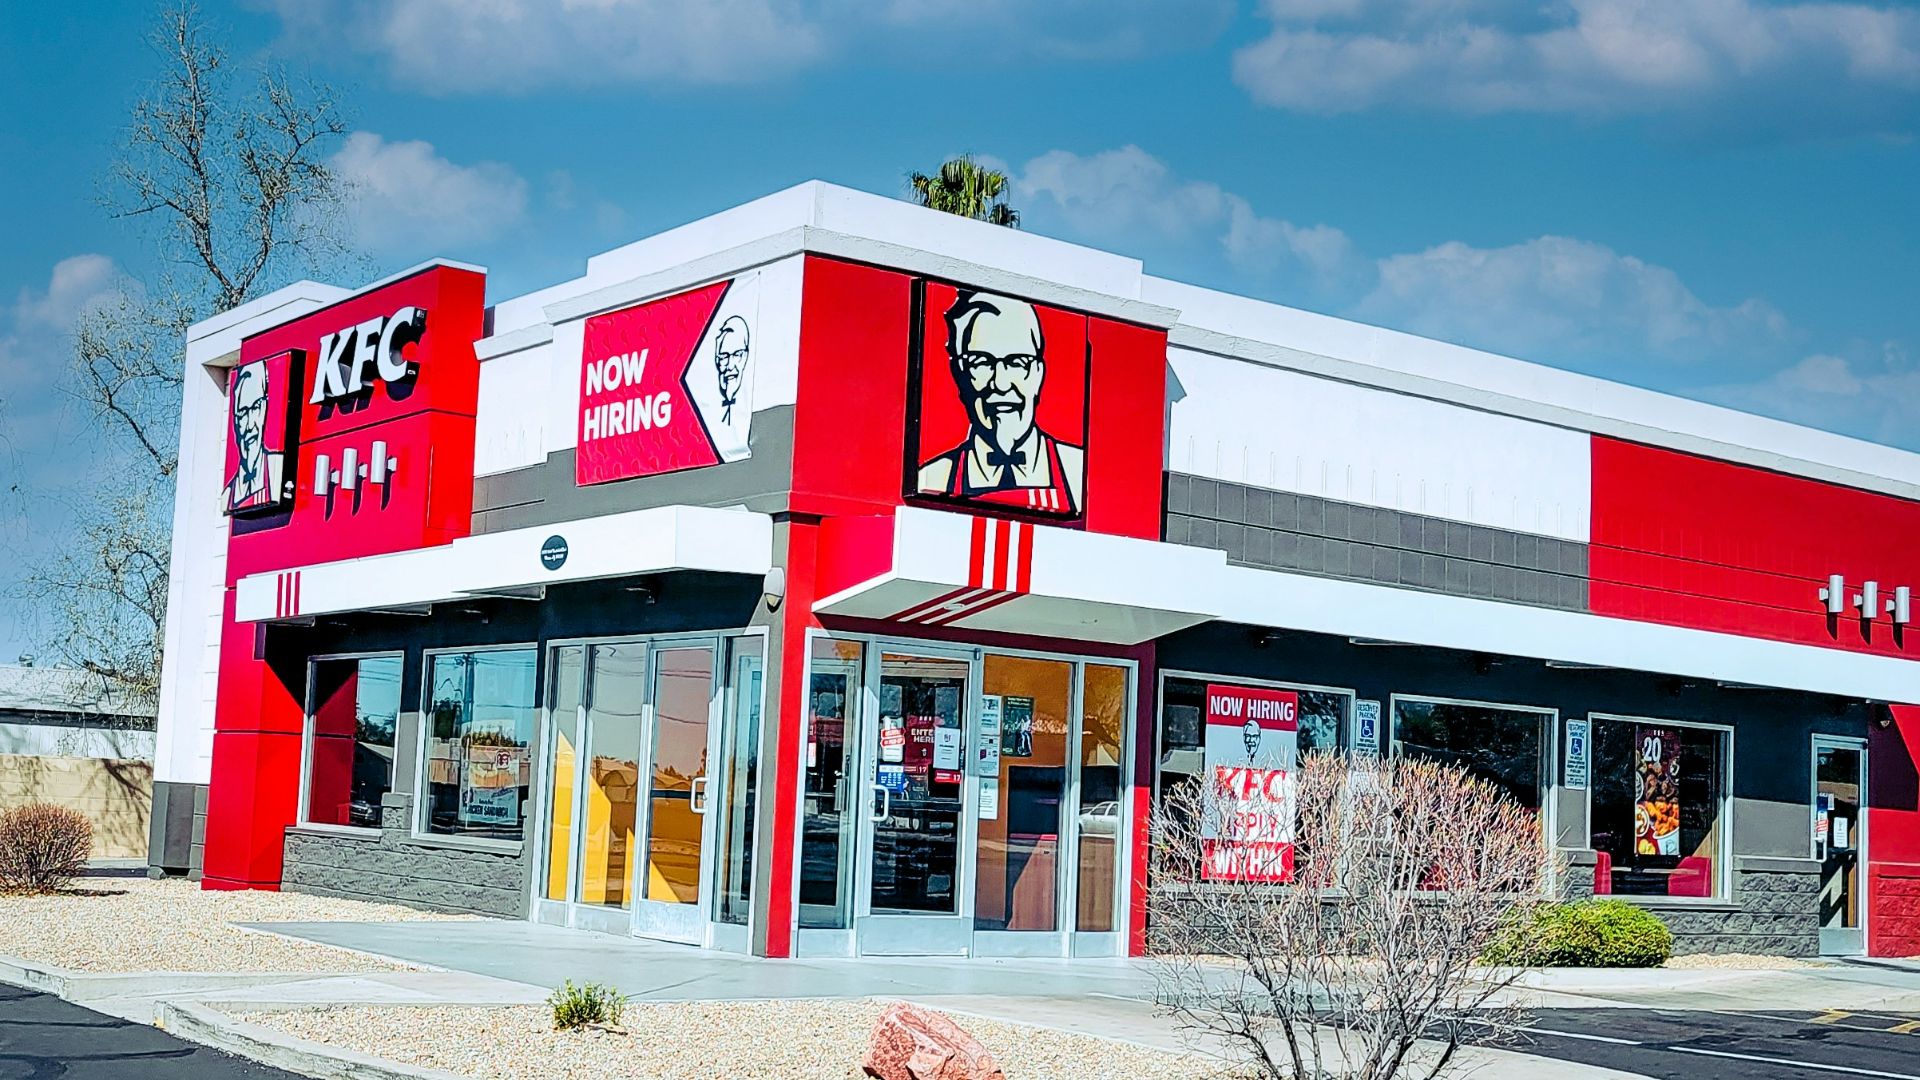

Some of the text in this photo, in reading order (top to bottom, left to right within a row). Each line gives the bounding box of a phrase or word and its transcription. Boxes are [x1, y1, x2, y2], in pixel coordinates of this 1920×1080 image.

[309, 306, 416, 404] KFC
[586, 348, 649, 396] NOW
[583, 391, 672, 442] HIRING
[1210, 695, 1294, 721] NOW HIRING
[911, 728, 934, 736] ENTE
[953, 774, 961, 782] 17
[1215, 765, 1287, 803] KFC
